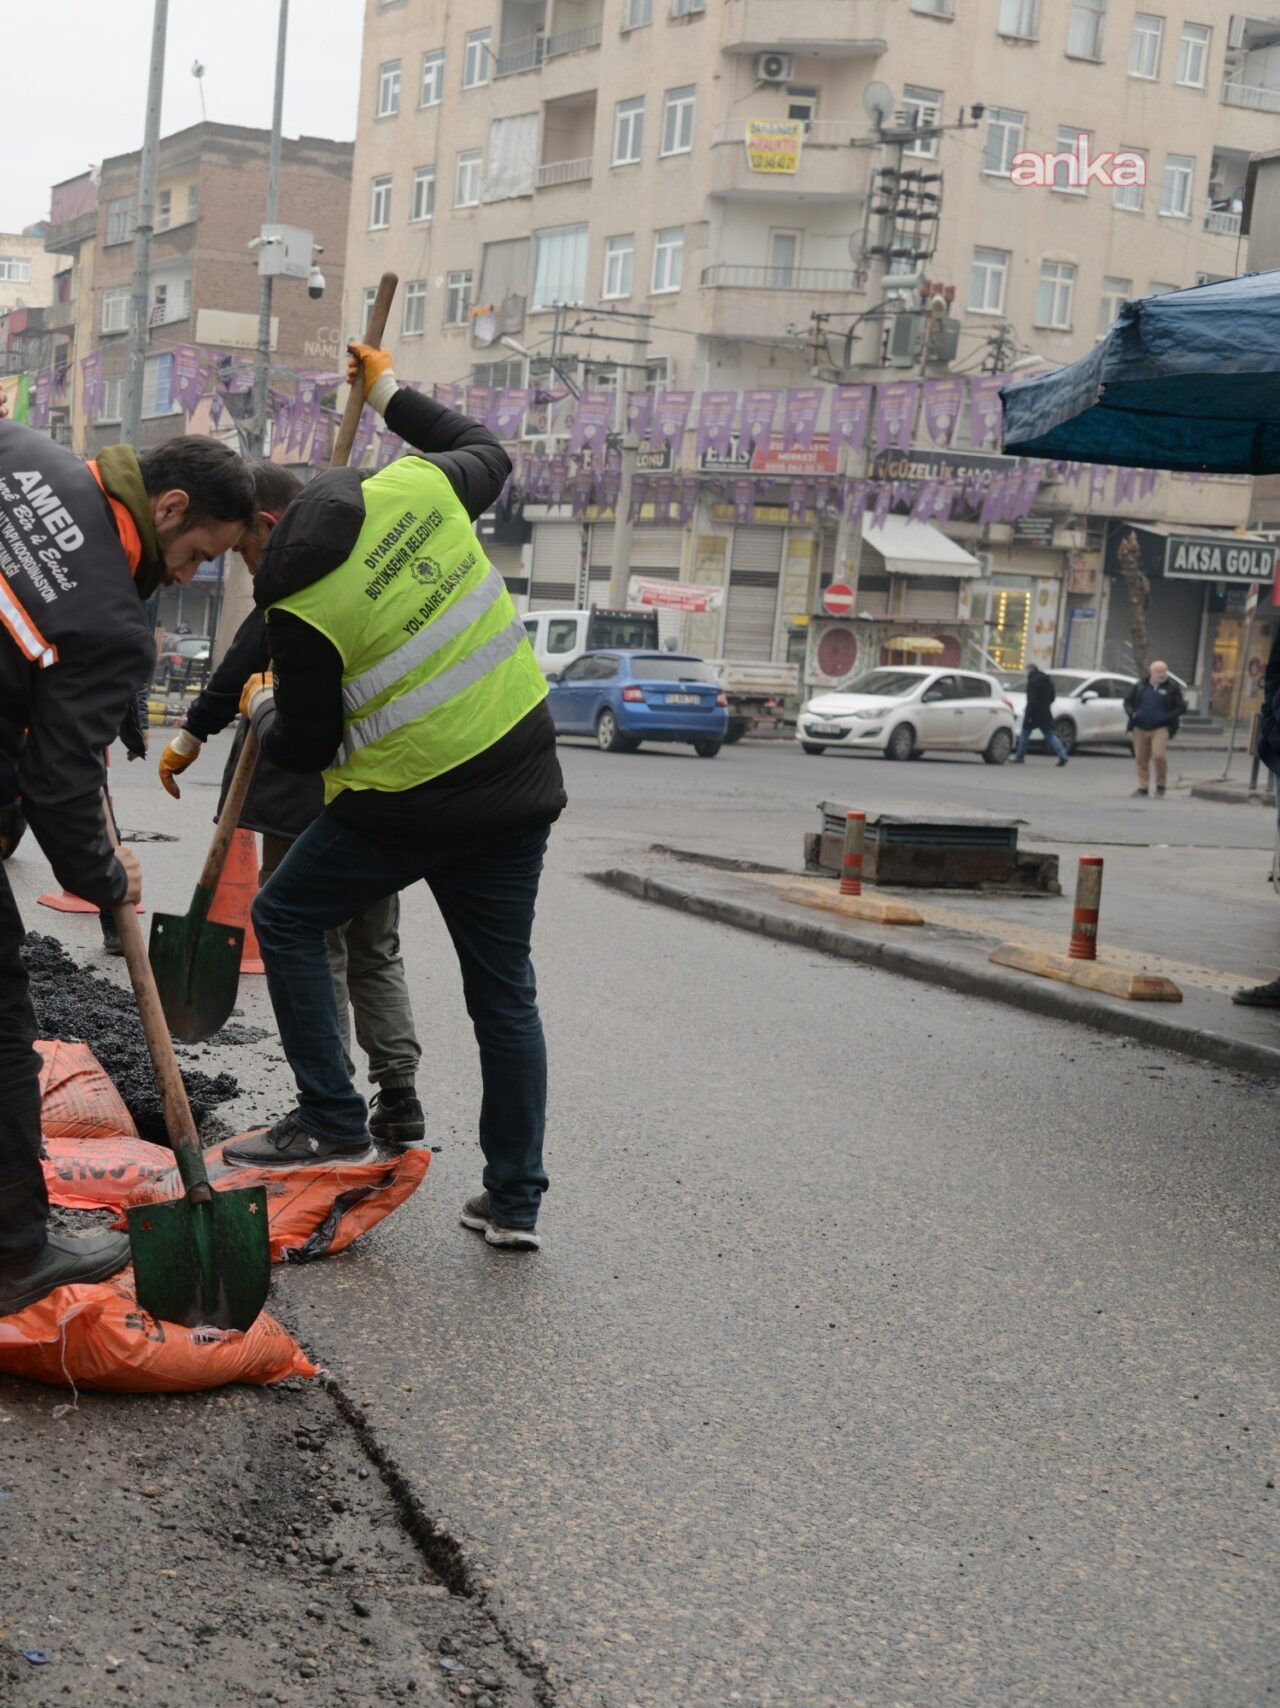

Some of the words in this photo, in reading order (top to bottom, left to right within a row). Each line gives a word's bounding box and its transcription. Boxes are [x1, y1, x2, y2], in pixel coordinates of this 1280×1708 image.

[888, 458, 955, 480] GÜZELLİK
[1, 522, 22, 544] YAPI
[12, 470, 84, 552] AMED
[363, 511, 418, 570] DİYARBAKIR
[11, 538, 58, 603] KOORDİNASYON
[364, 548, 411, 601] BÜYÜKŞEHİR
[404, 506, 444, 554] BELEDİYESİ
[1174, 544, 1222, 572] AKSA
[1226, 549, 1272, 576] GOLD
[402, 616, 424, 636] YOL
[419, 589, 446, 619] DAİRE
[440, 551, 478, 595] BAŞKANLIĞI
